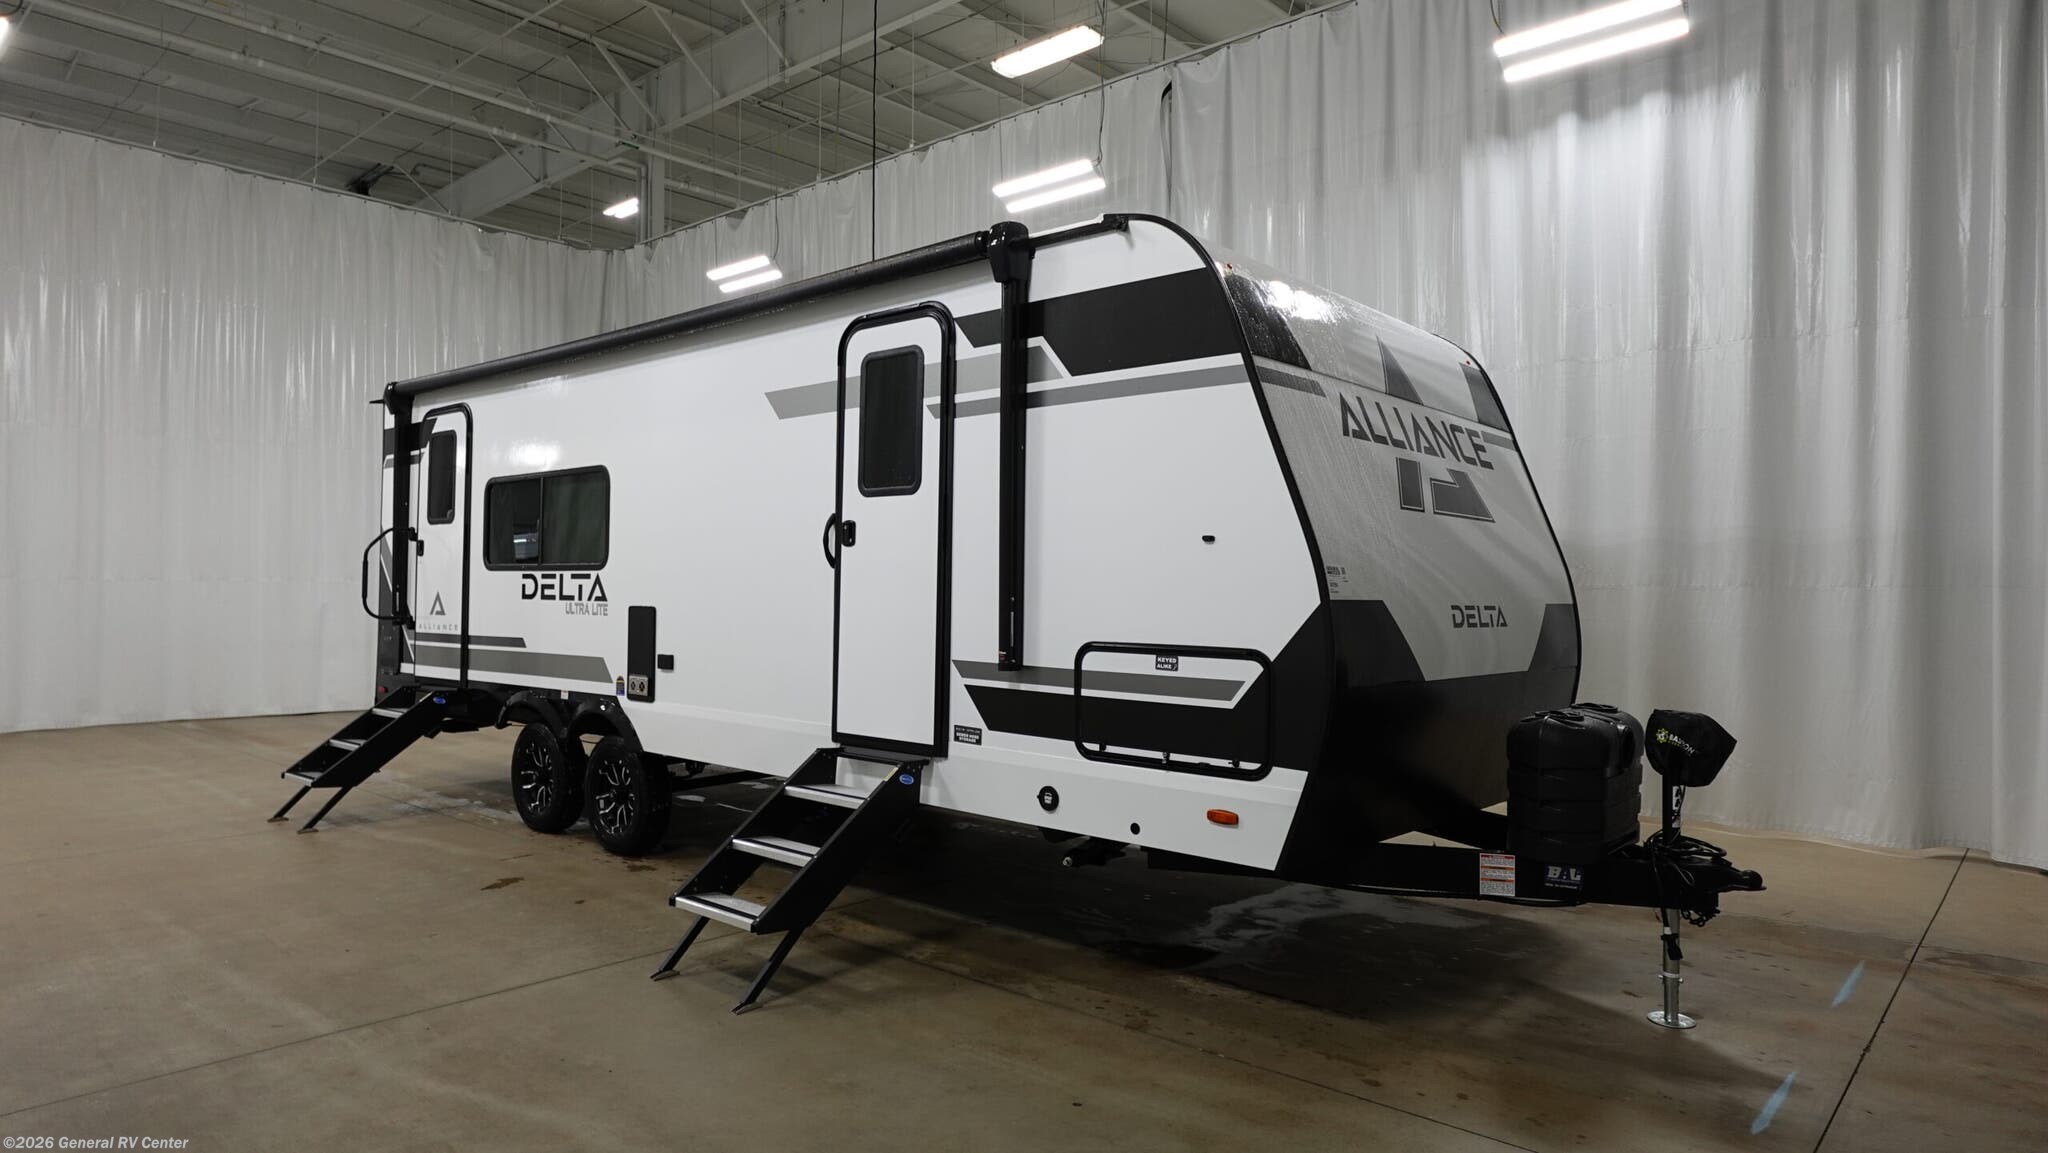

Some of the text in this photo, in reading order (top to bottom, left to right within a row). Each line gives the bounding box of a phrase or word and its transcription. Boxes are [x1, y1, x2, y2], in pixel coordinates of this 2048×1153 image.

[1339, 391, 1495, 471] ALLIANCE
[521, 572, 608, 602] DELTA
[565, 602, 609, 616] ULTRA LITE
[1450, 604, 1508, 629] DELTA
[418, 623, 459, 631] ALLIANCE
